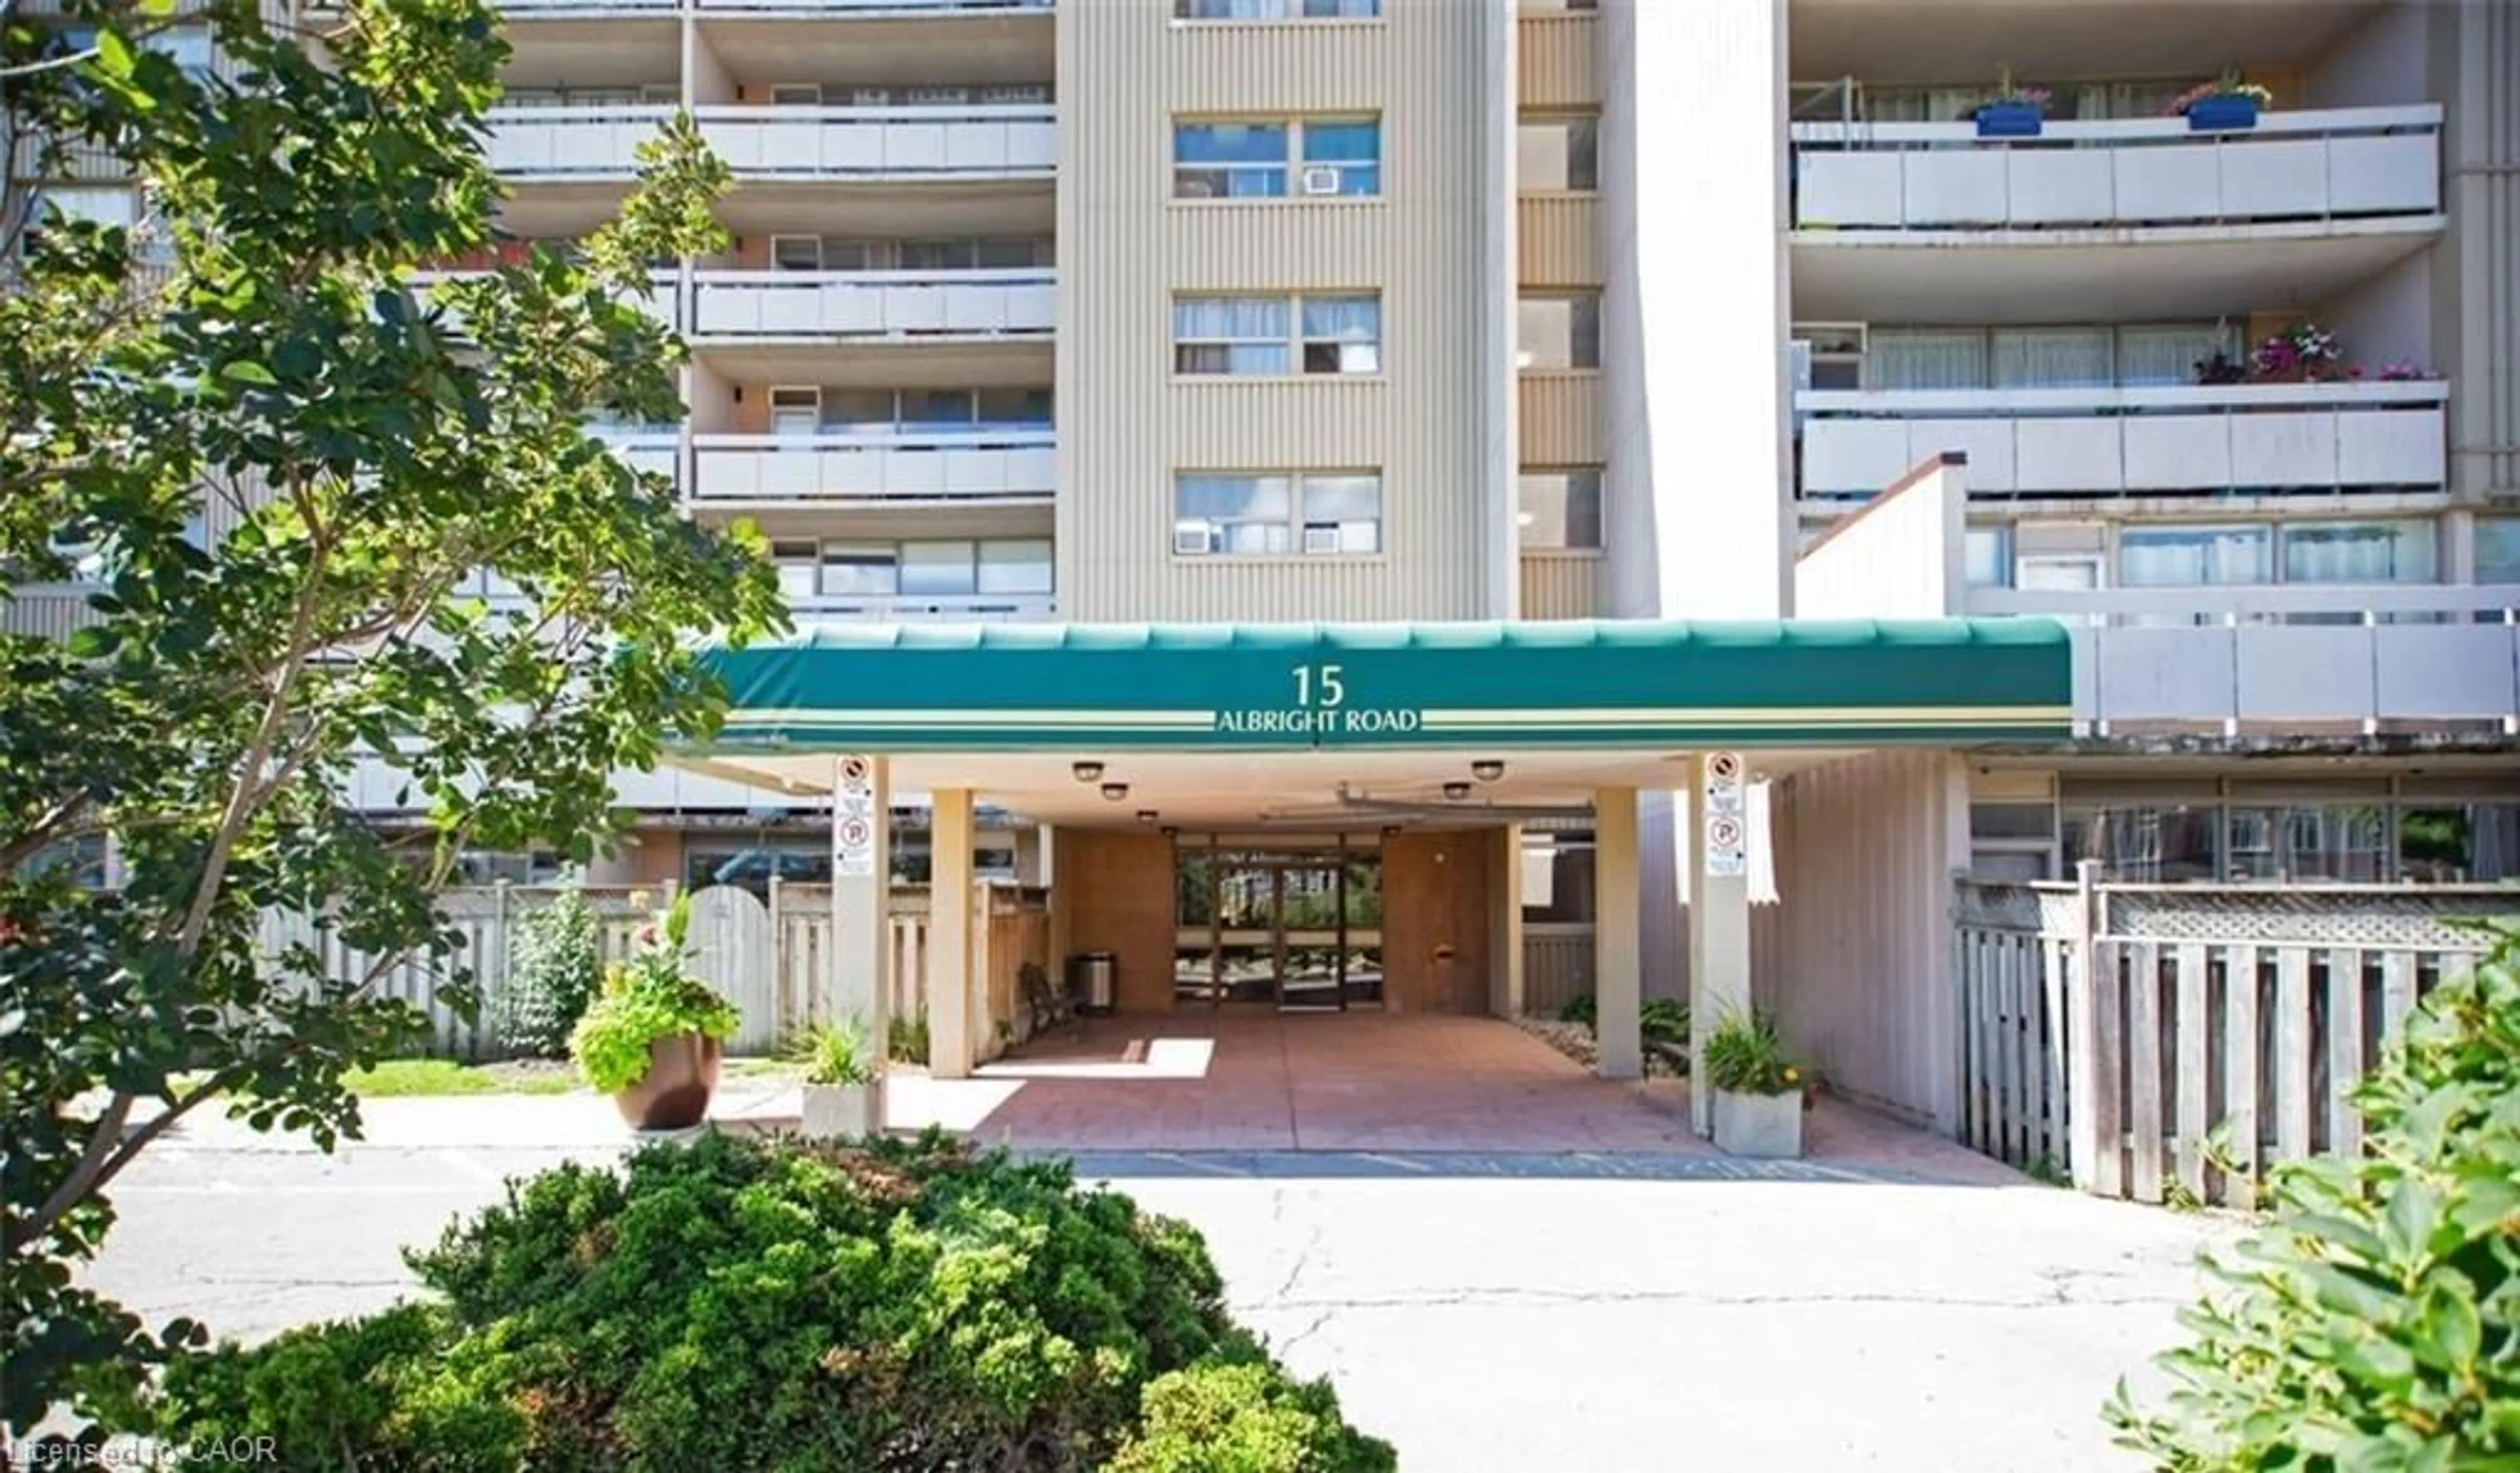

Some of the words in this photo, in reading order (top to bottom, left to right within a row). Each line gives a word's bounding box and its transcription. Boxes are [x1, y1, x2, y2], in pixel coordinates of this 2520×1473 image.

[1292, 664, 1345, 707] 15
[1218, 710, 1340, 732] ALBRIGHT
[1346, 710, 1418, 732] ROAD
